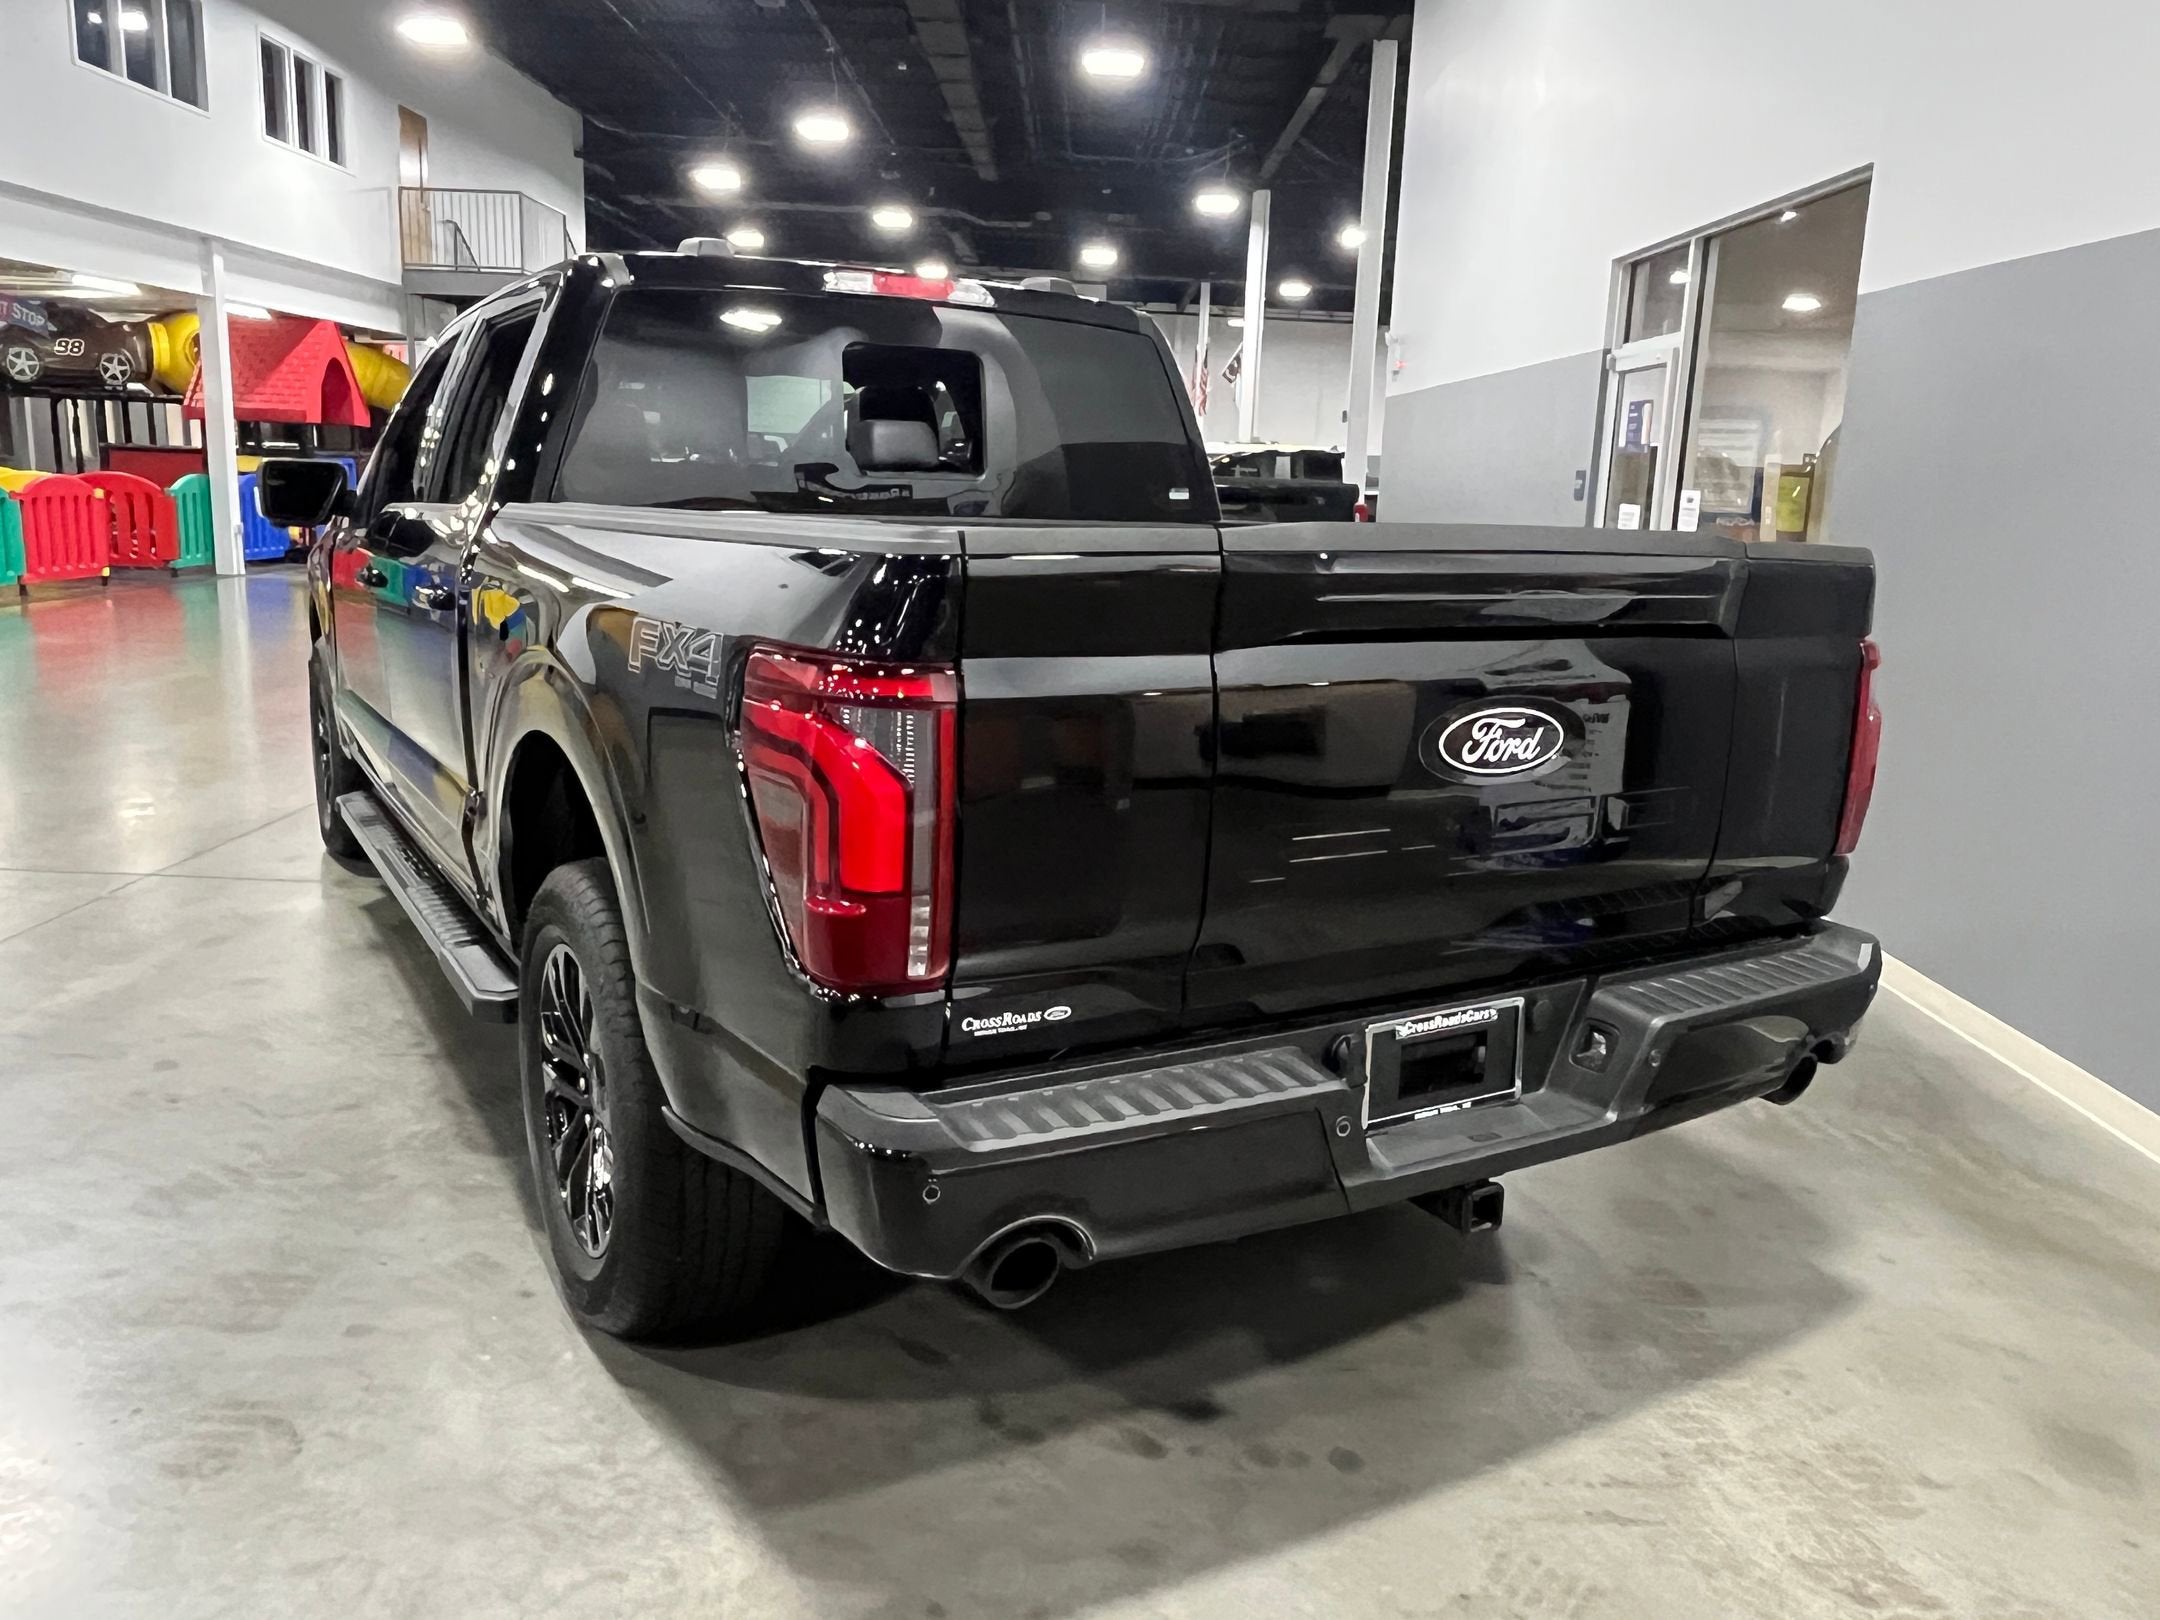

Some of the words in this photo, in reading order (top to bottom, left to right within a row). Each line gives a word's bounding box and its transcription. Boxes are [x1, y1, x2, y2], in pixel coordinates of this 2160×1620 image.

[11, 302, 46, 327] STOP
[627, 616, 724, 687] FX4
[1461, 717, 1541, 764] Ford
